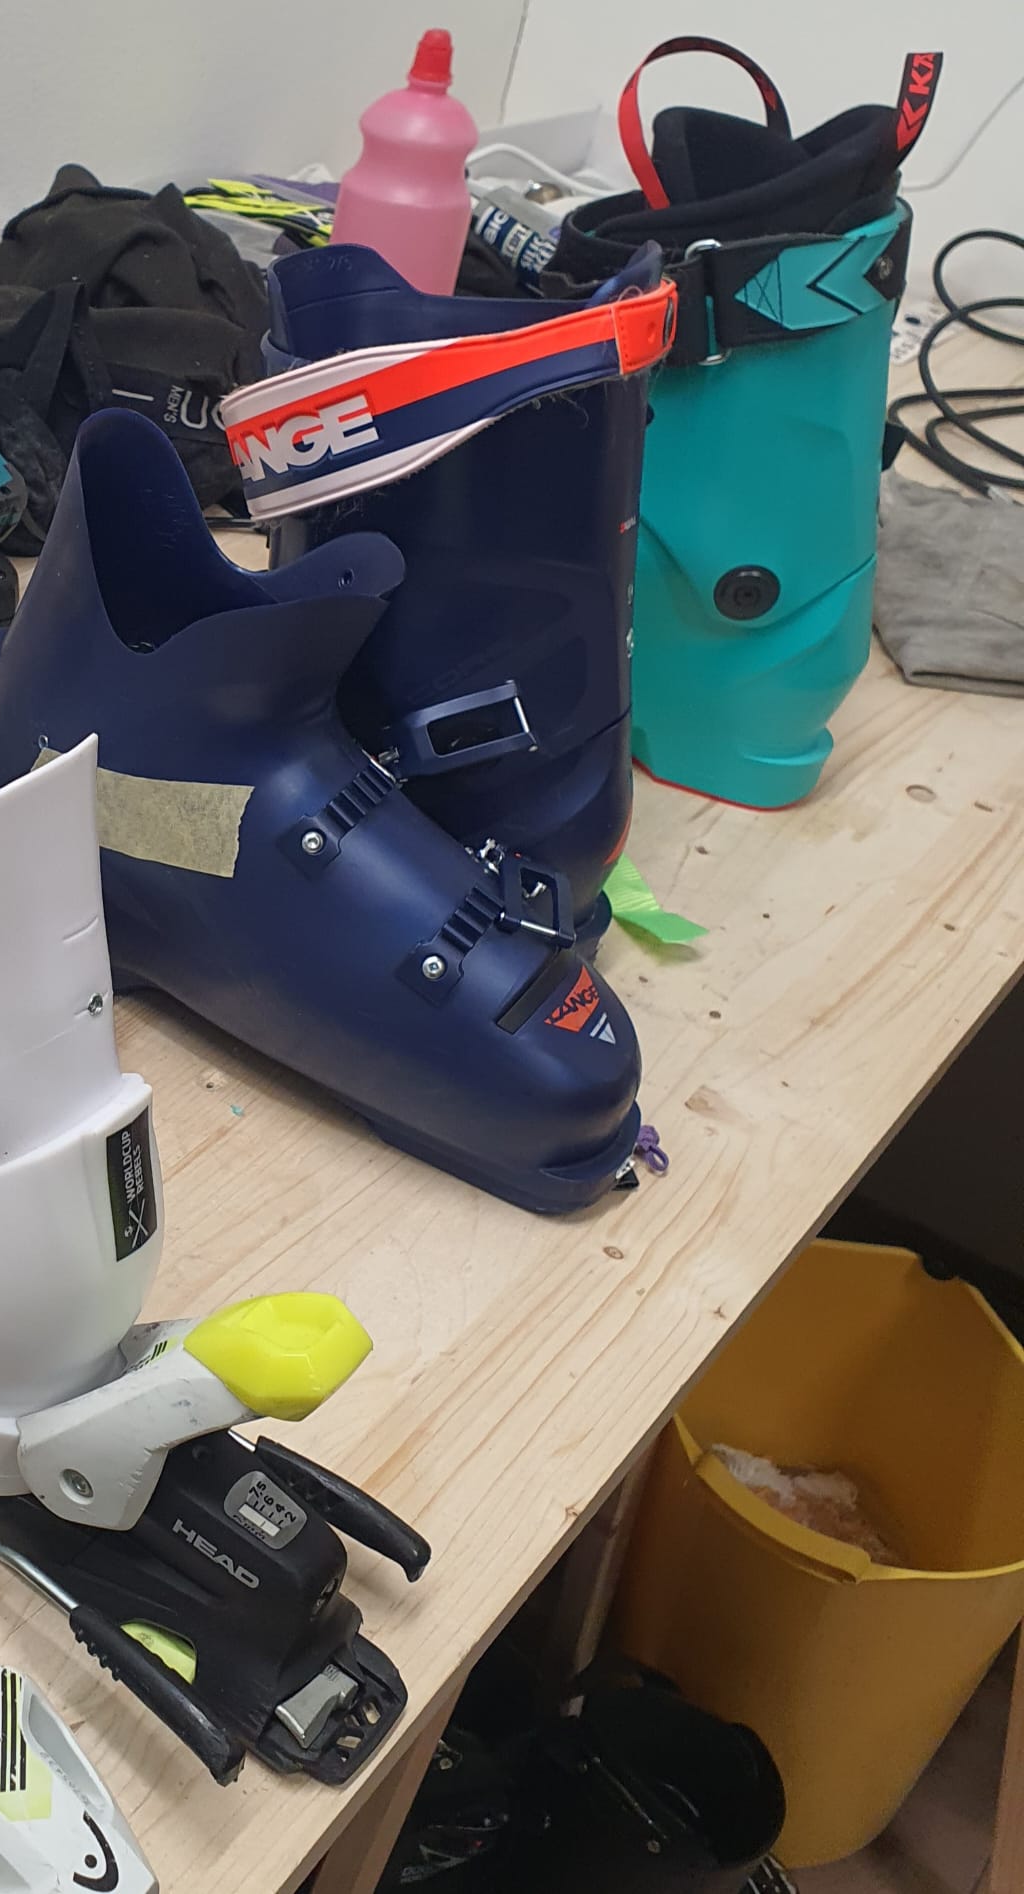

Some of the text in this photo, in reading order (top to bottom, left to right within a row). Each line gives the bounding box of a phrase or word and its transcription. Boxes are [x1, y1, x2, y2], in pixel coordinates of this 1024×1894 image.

[121, 1129, 137, 1204] WORLDCUP
[132, 1143, 145, 1195] REBELS
[248, 1481, 267, 1499] 7.5
[263, 1495, 275, 1507] 6
[275, 1503, 286, 1514] 4
[284, 1511, 297, 1524] 2
[171, 1517, 261, 1590] HEAD
